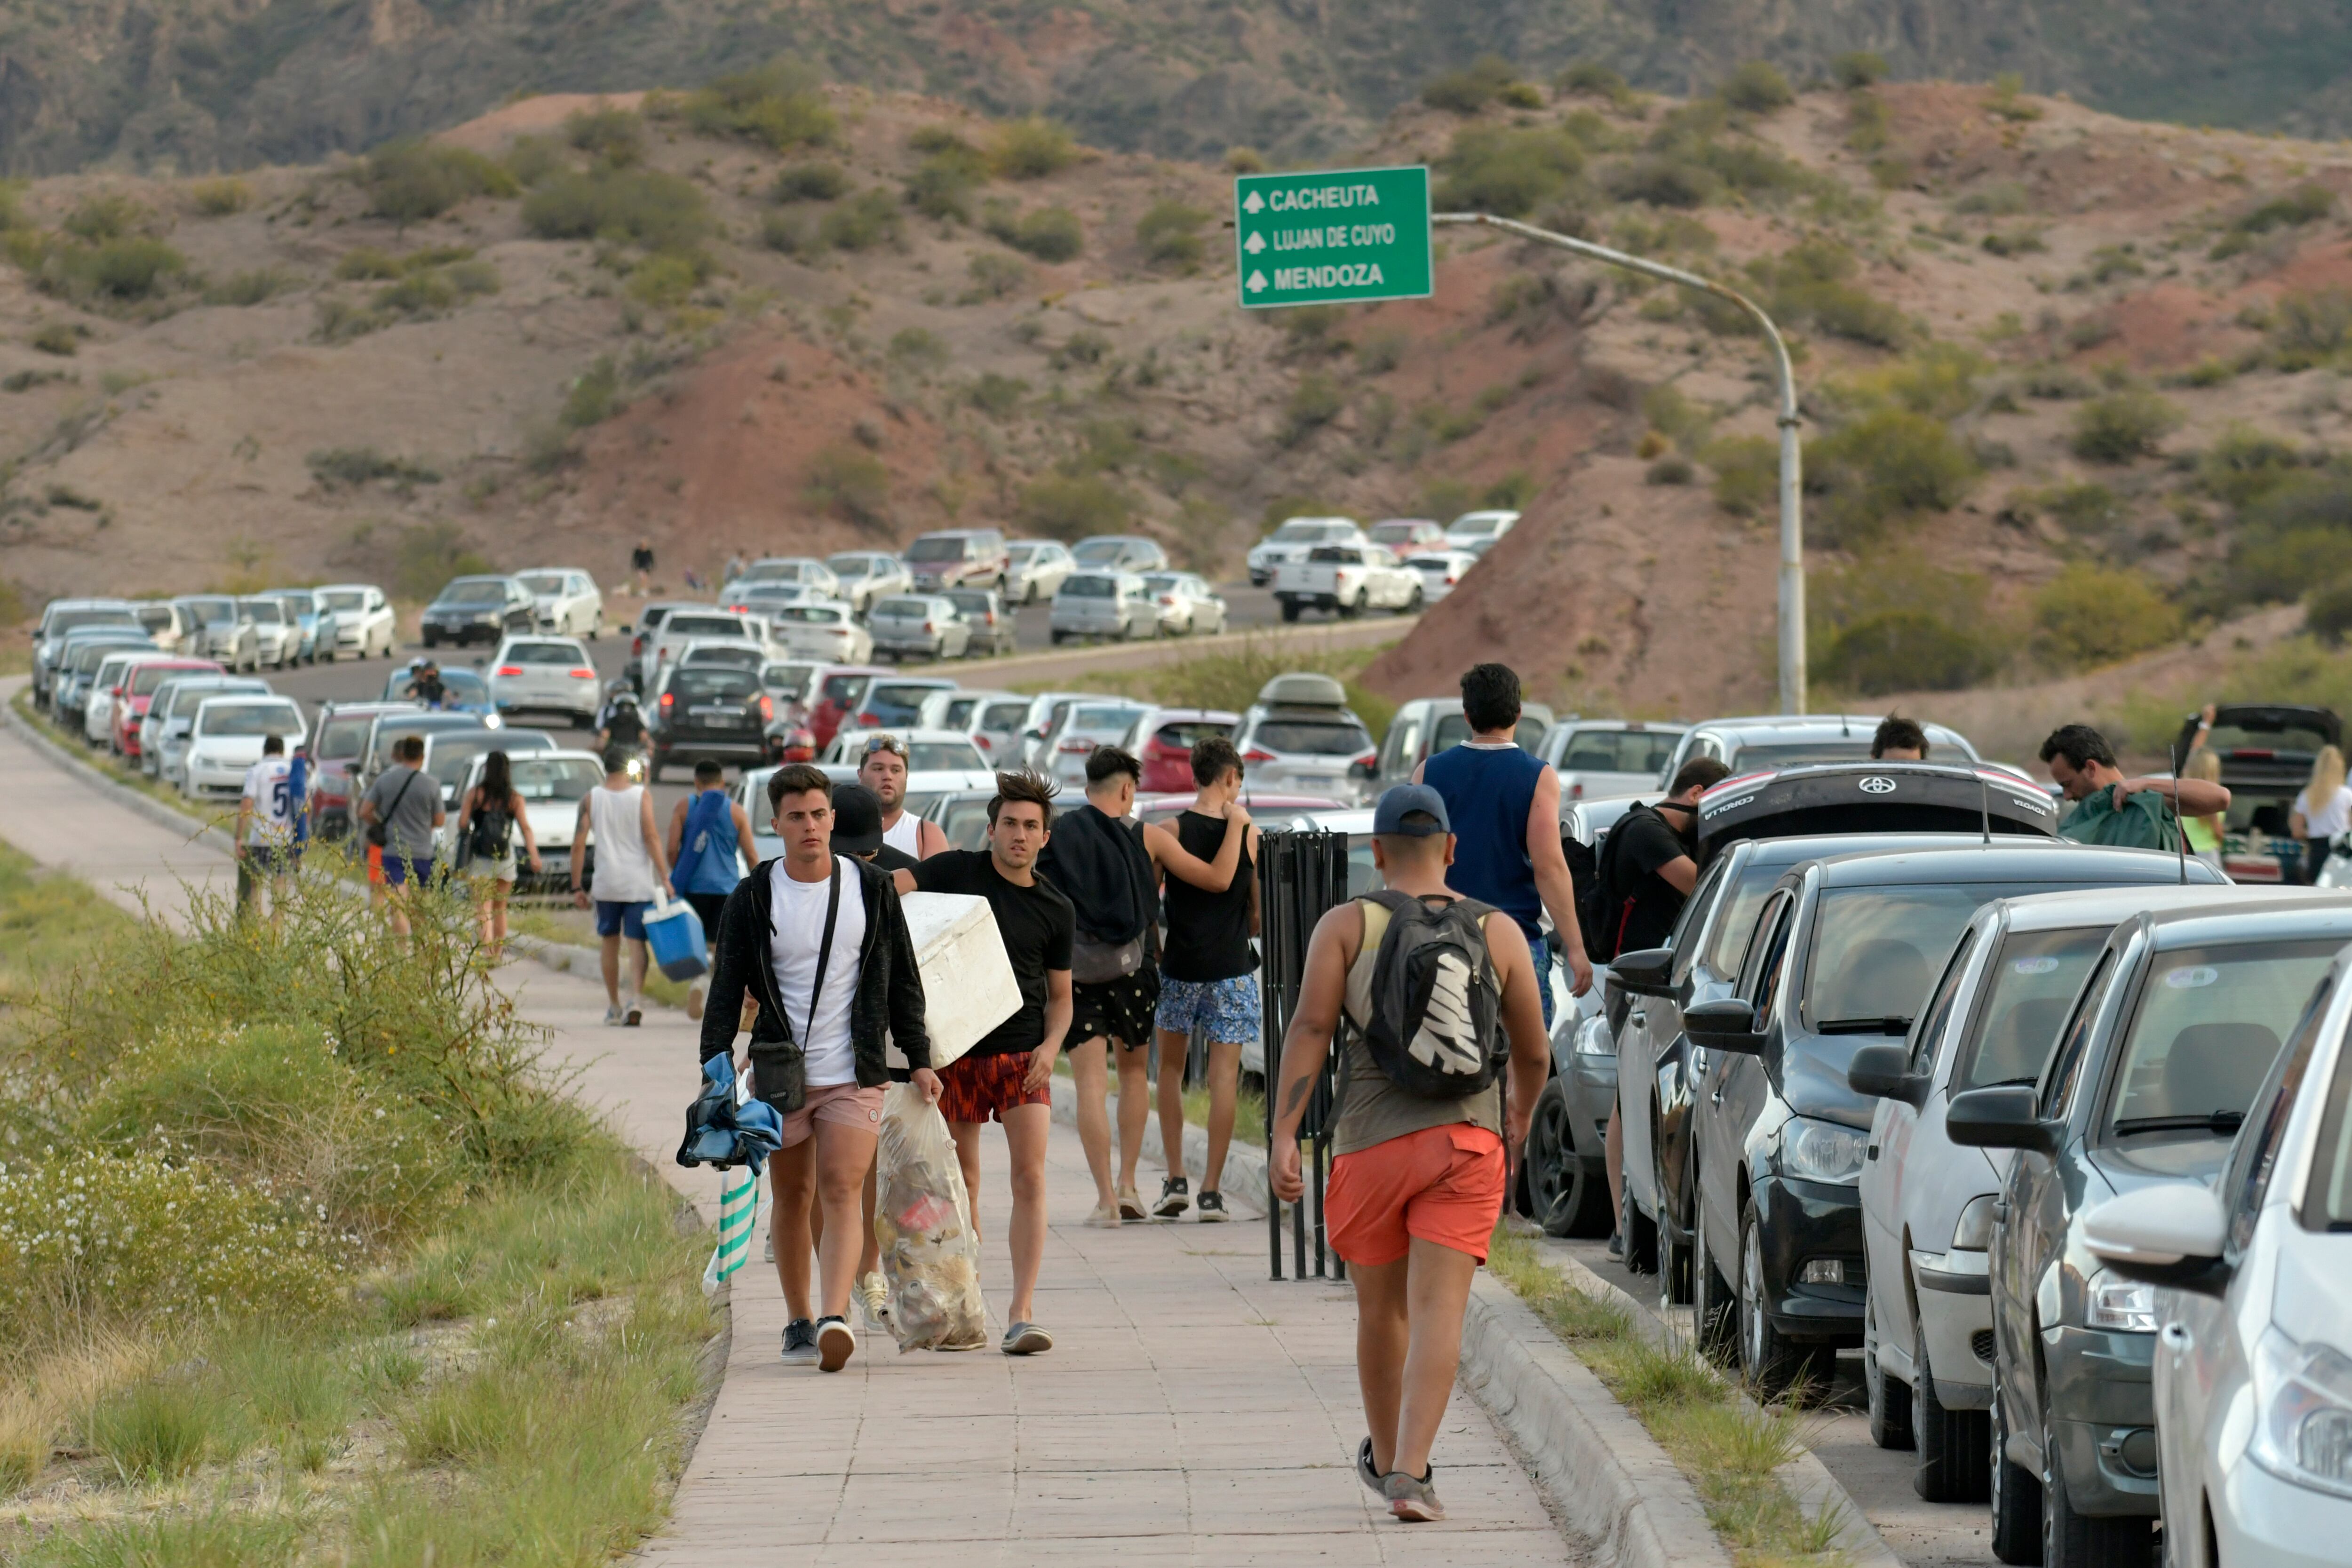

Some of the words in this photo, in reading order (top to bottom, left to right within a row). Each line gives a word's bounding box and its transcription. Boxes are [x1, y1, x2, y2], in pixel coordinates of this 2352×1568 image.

[1270, 185, 1379, 212] CACHEUTA
[1273, 228, 1324, 251] LUJAN
[1326, 225, 1349, 248] DE
[1351, 223, 1396, 247] CUYO
[1274, 263, 1384, 290] MENDOZA
[273, 782, 288, 817] 5
[1704, 796, 1755, 821] COROLLA
[2013, 799, 2046, 816] TOYOTA
